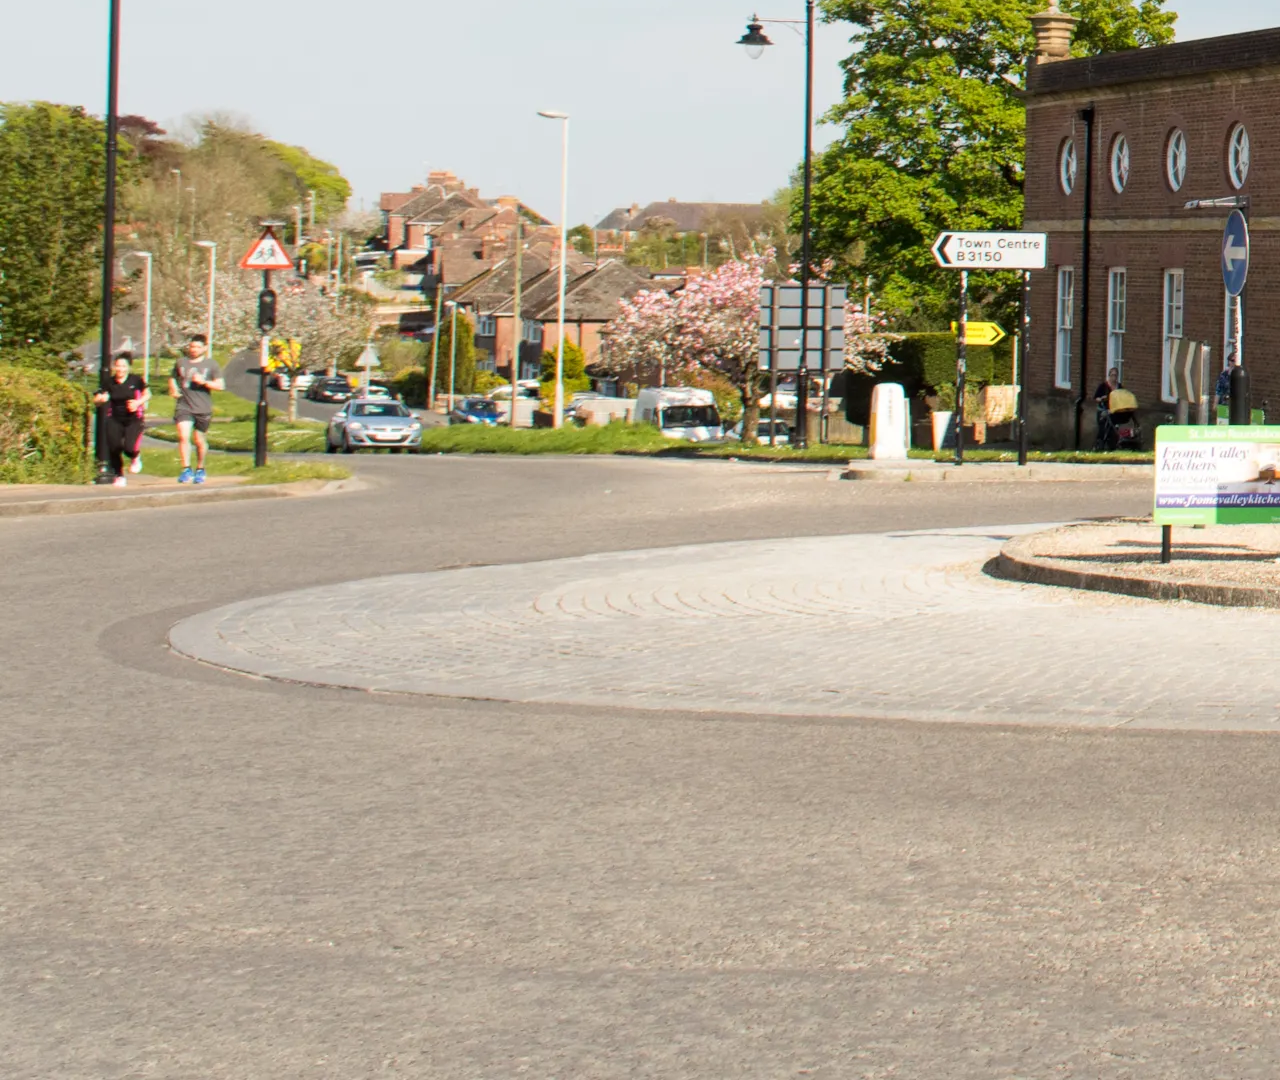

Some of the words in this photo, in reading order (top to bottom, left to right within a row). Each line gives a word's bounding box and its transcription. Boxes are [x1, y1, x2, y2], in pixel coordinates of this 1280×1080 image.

[957, 237, 991, 249] Town
[997, 238, 1041, 249] Centre
[1162, 446, 1206, 459] Frome
[1210, 446, 1250, 462] Valley
[1161, 459, 1217, 472] Kitchens
